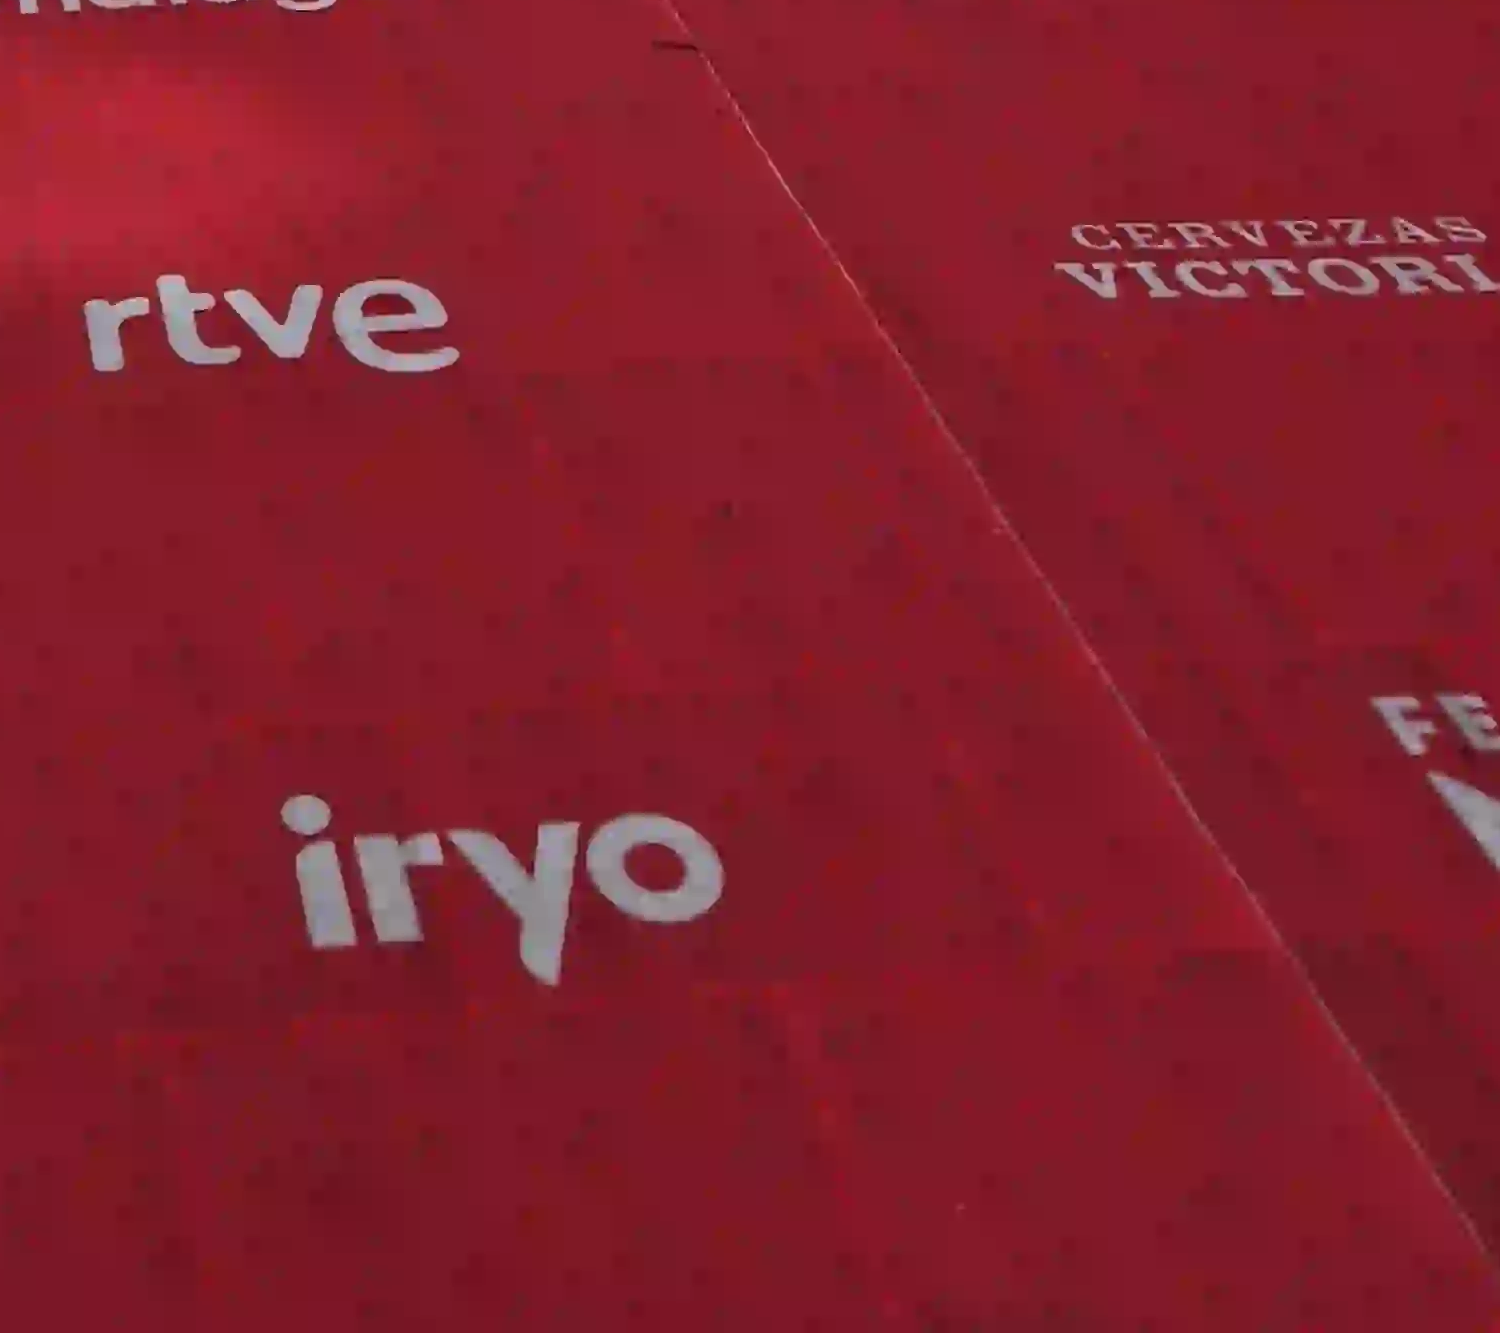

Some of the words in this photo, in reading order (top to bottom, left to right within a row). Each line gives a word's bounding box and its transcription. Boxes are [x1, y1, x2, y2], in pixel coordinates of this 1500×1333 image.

[1070, 216, 1488, 251] CERVEZAS
[83, 274, 460, 373] rtve
[280, 793, 725, 987] iryo
